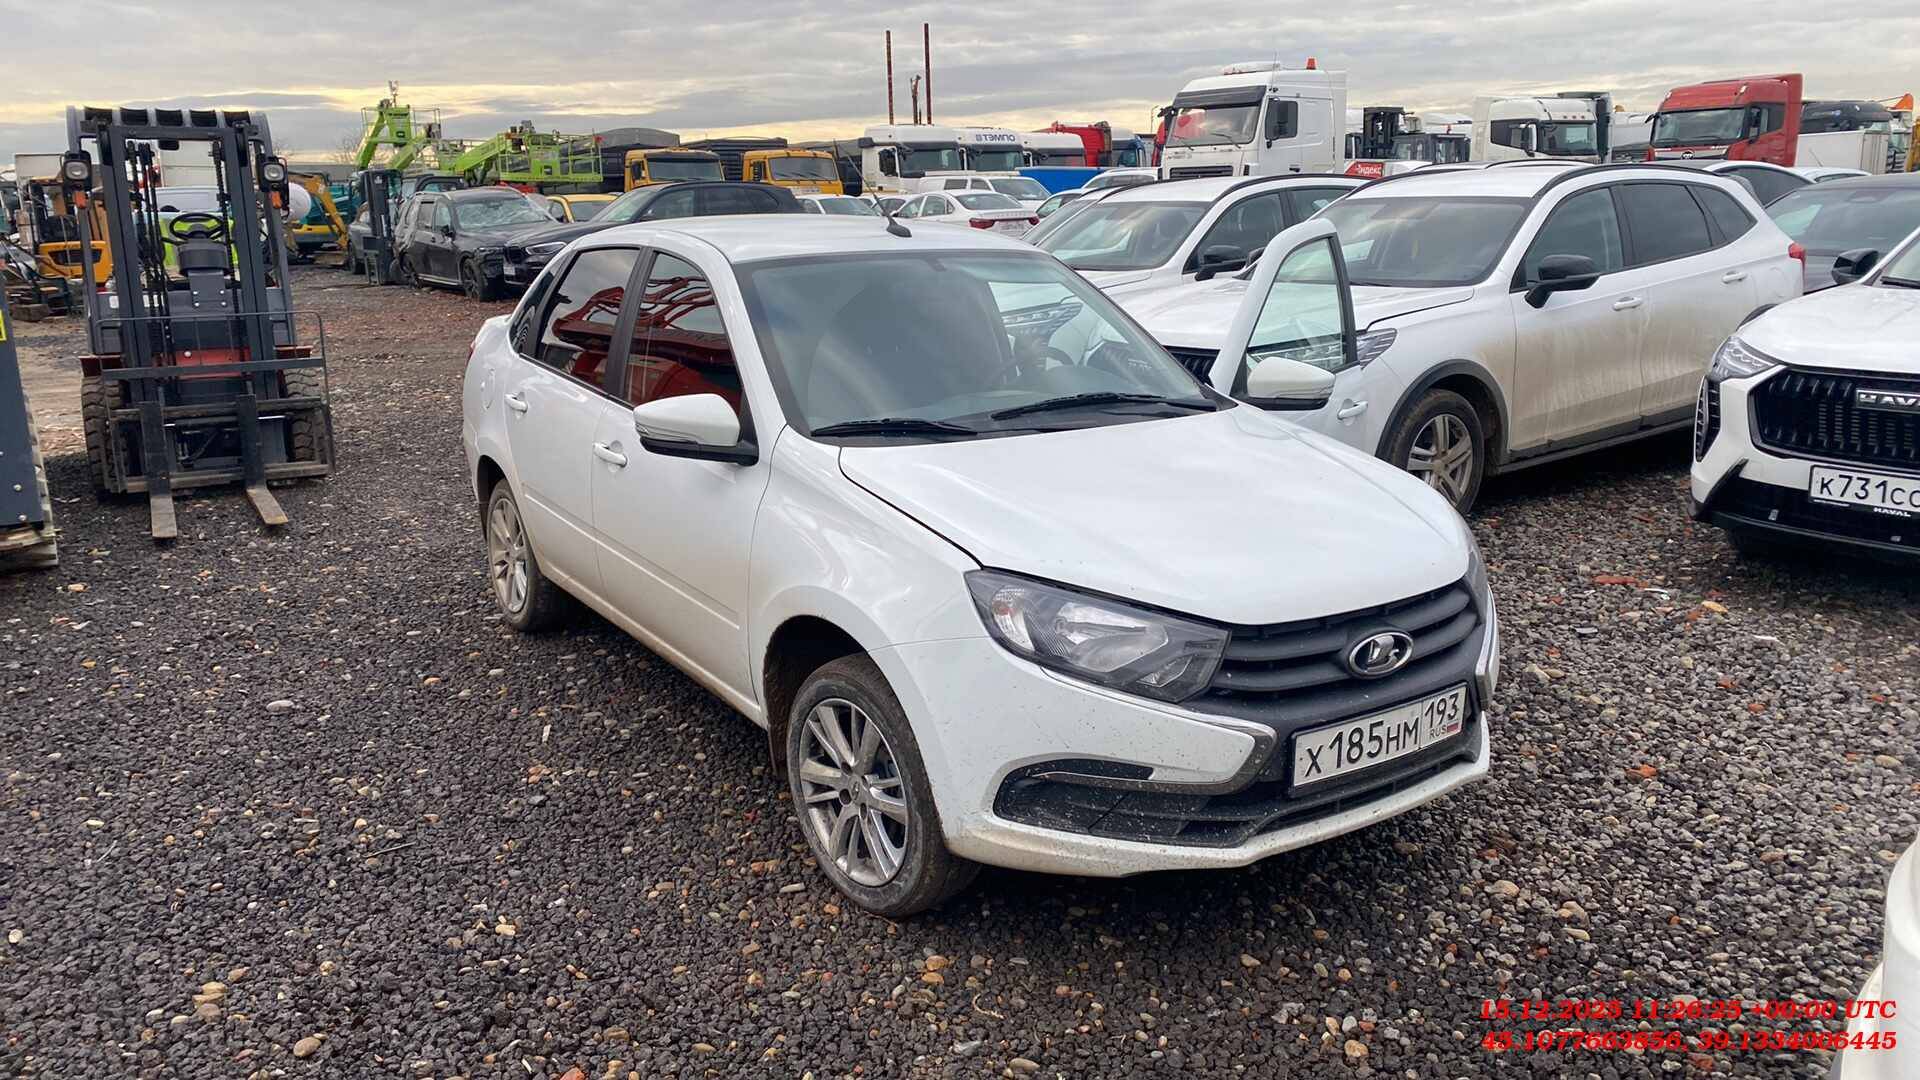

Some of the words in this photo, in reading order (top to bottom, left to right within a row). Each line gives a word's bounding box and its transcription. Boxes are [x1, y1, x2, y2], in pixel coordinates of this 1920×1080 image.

[1873, 506, 1911, 517] HAVAL
[1425, 692, 1460, 729] 193
[1429, 726, 1447, 739] RUS
